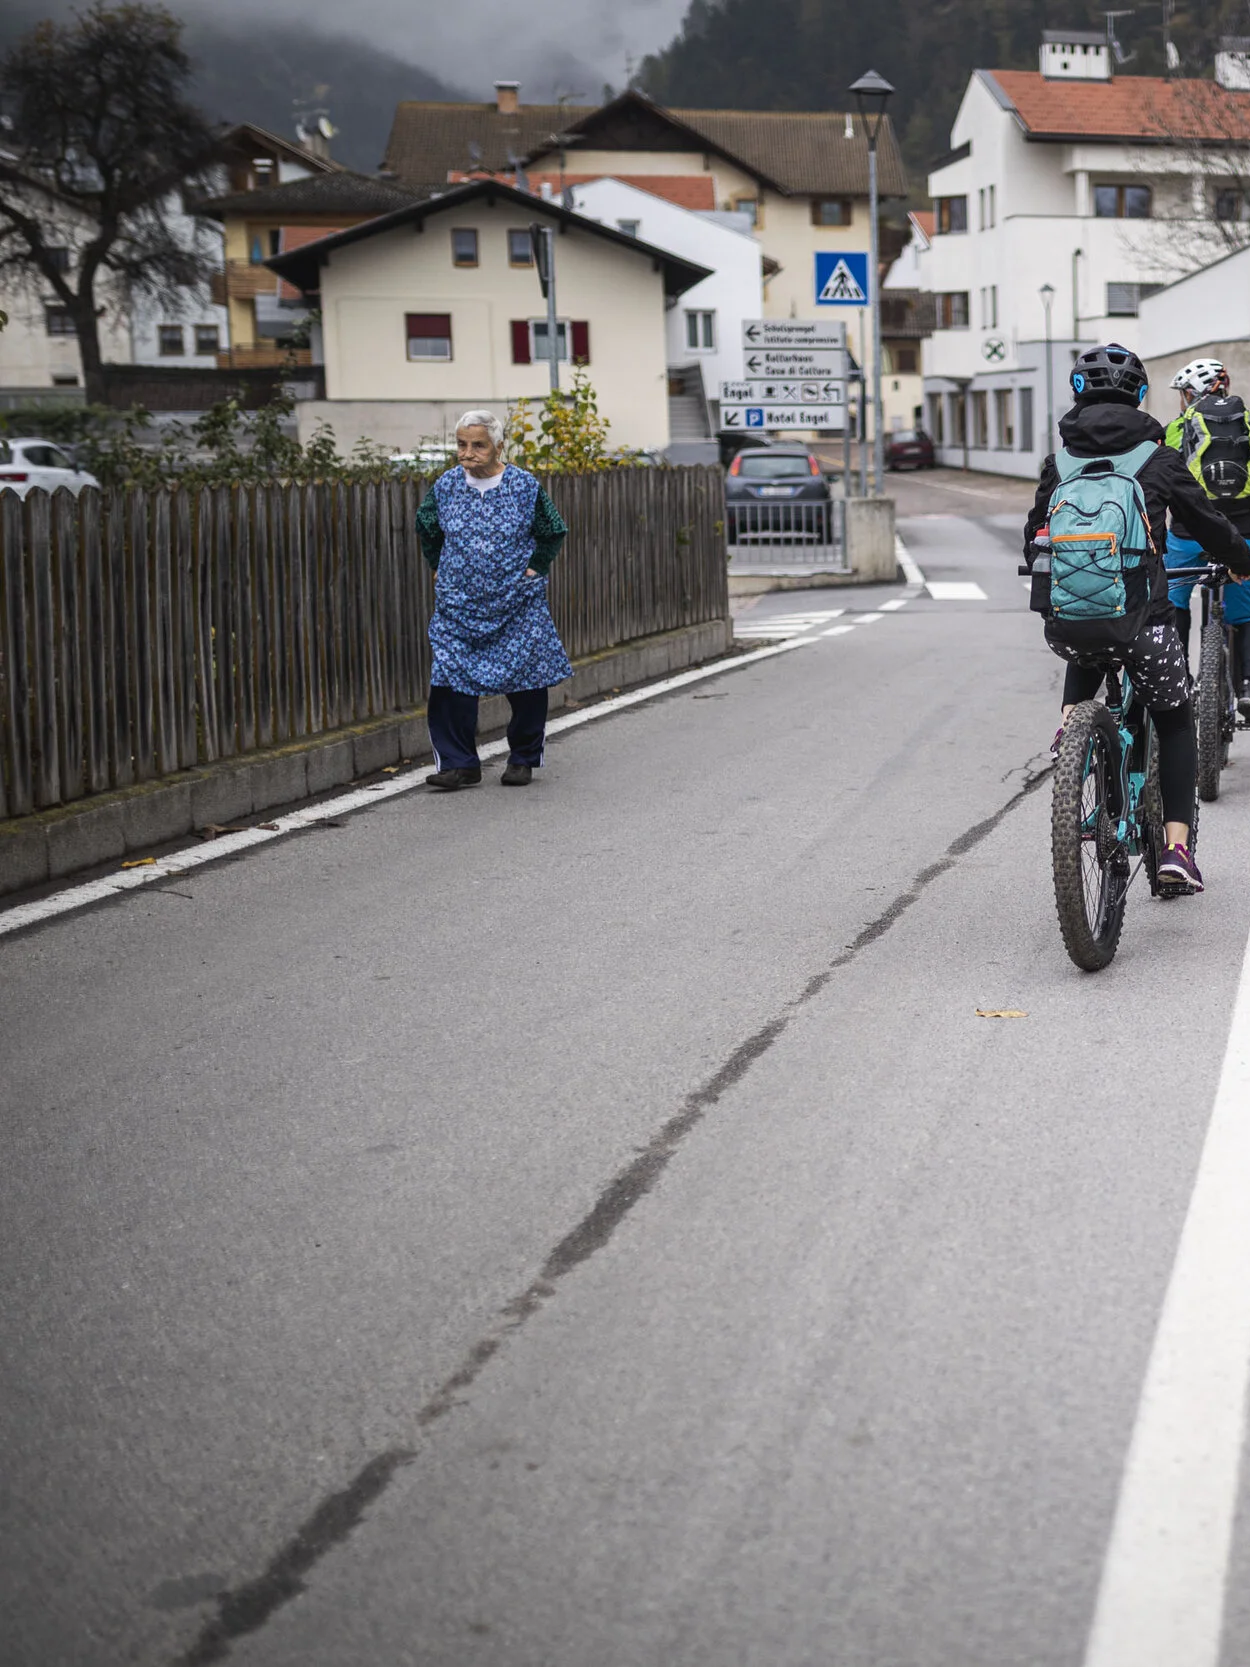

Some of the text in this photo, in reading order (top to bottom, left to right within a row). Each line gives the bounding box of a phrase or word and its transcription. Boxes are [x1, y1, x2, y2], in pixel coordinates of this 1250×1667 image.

[765, 366, 832, 375] Casa di Cultura
[723, 387, 753, 400] Engel
[766, 412, 795, 424] Hotel
[800, 412, 829, 425] Engel
